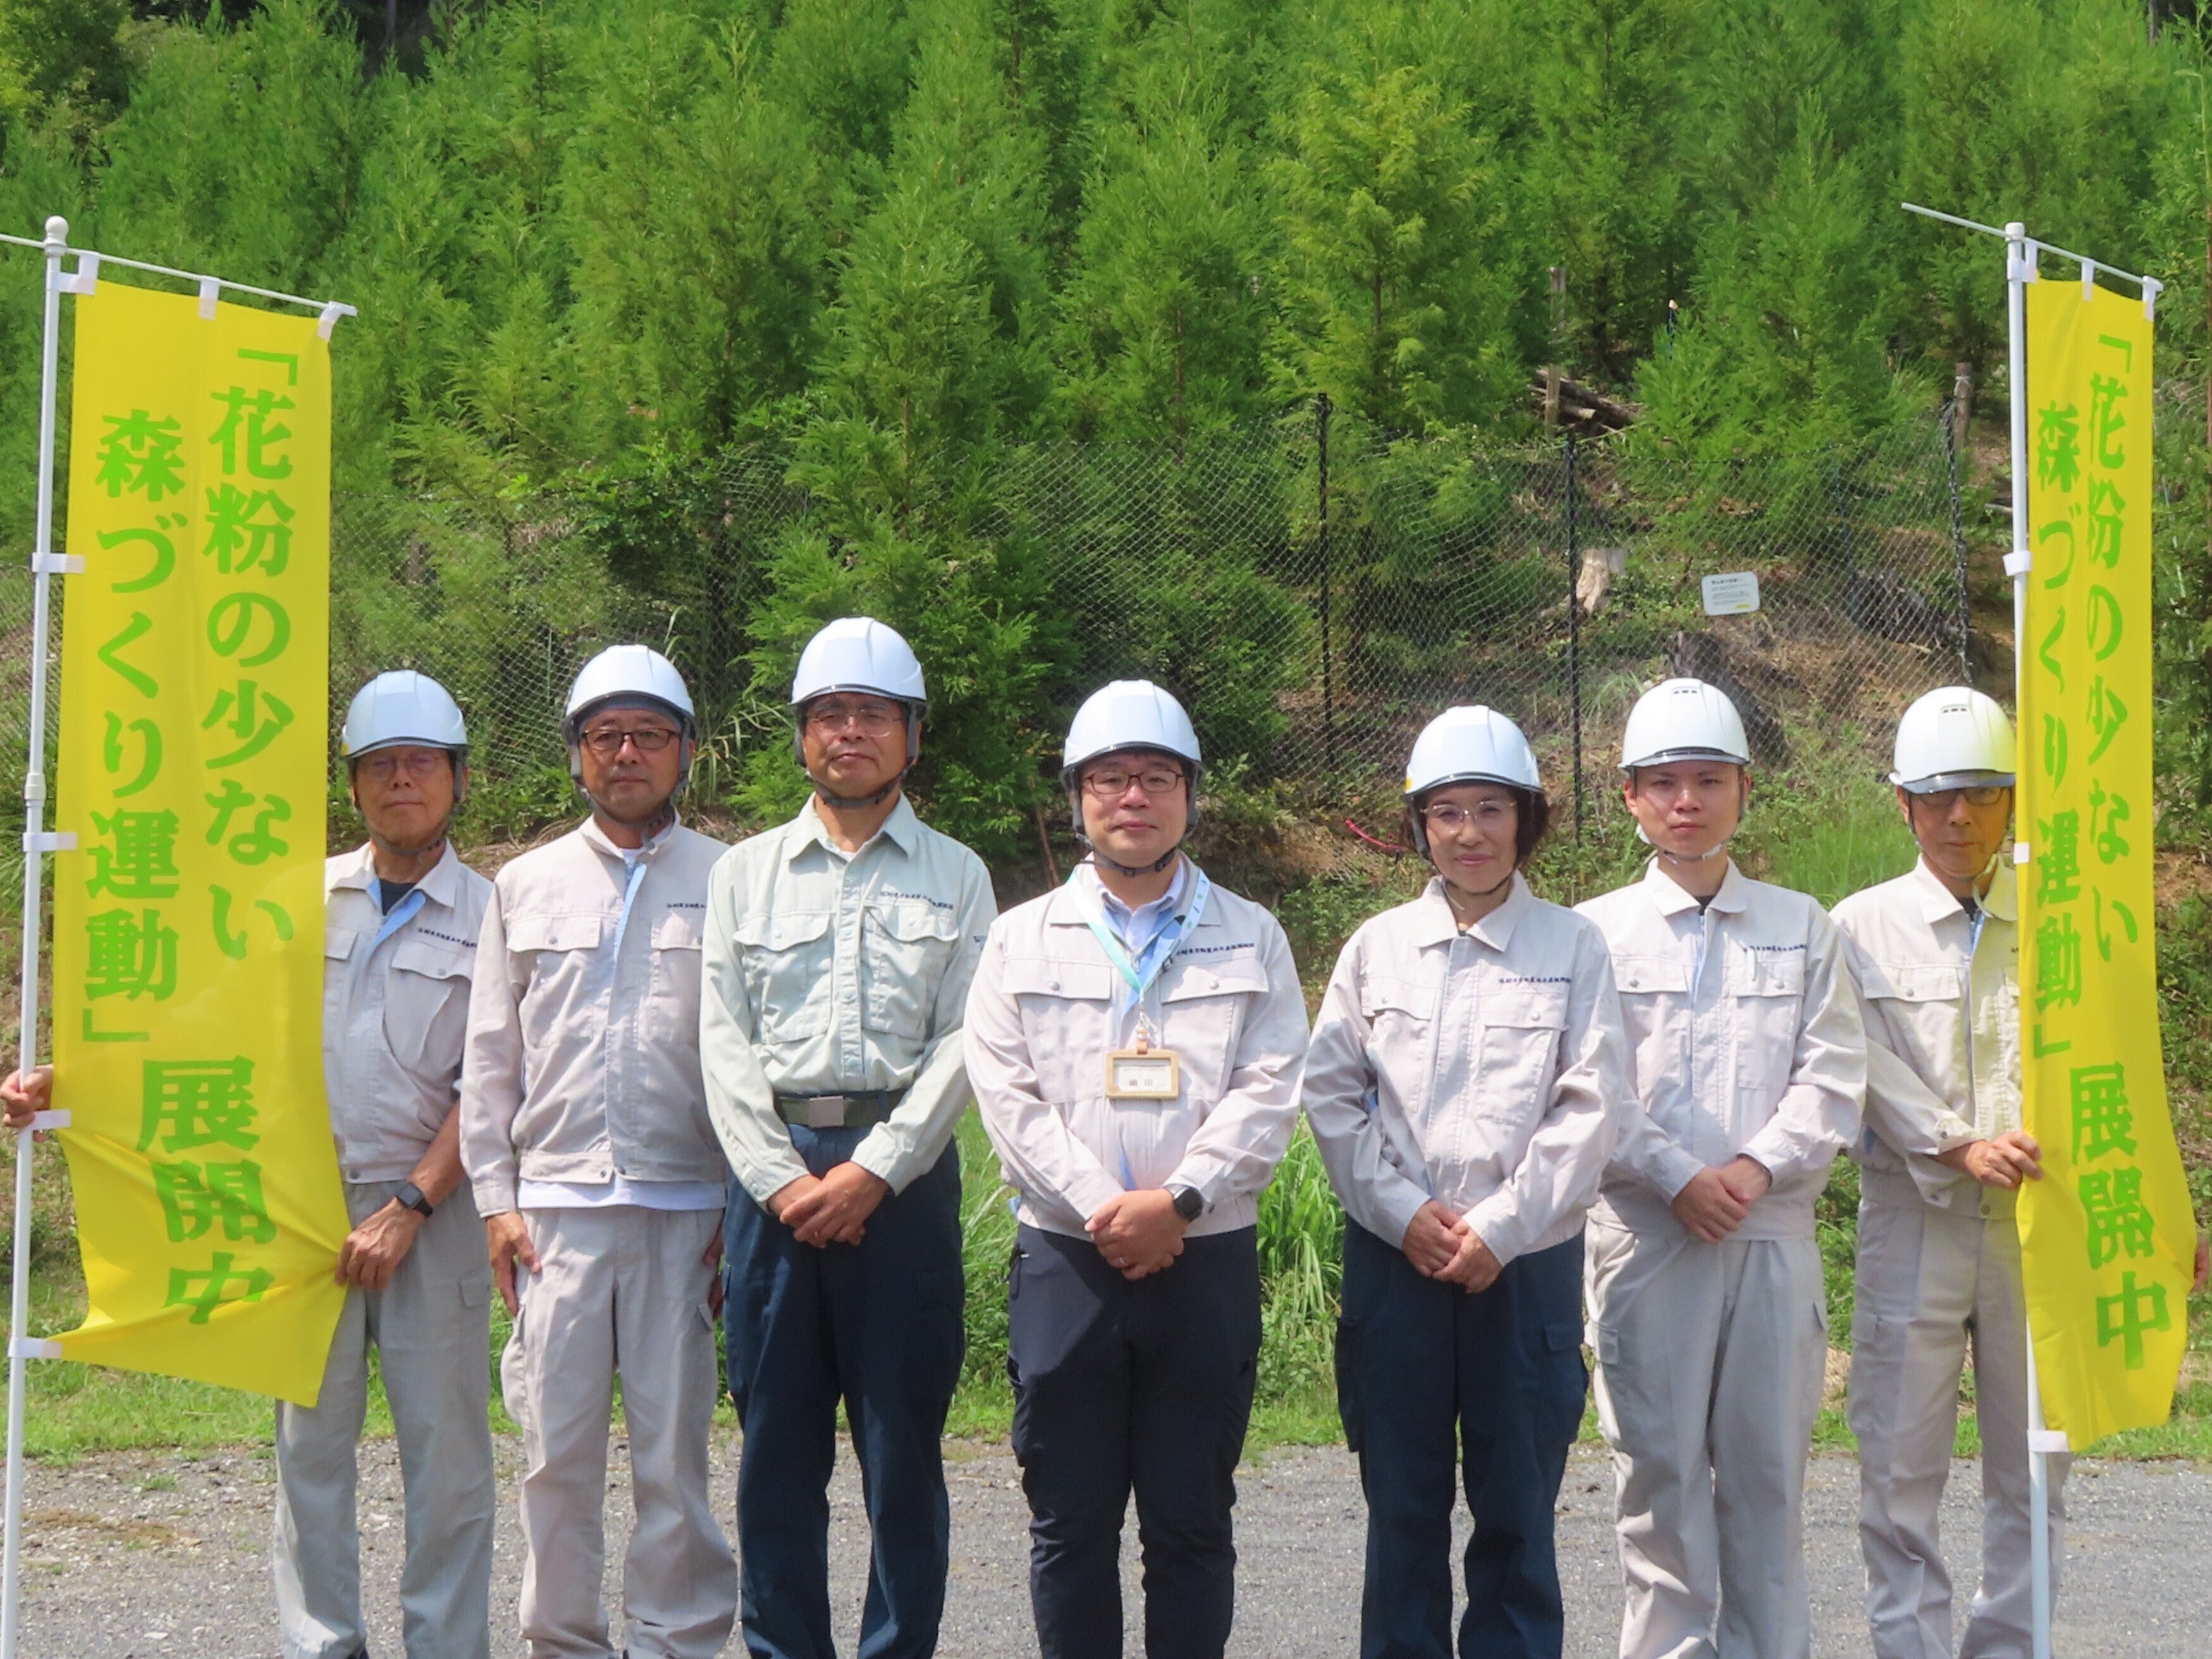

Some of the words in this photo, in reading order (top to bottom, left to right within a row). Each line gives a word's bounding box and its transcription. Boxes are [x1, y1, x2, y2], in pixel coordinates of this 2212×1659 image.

[83, 409, 188, 1042] 森づくり運動」
[202, 348, 298, 960] 「花粉の少ない
[2033, 401, 2082, 1058] 森づくり運動」
[2086, 335, 2138, 962] 「花粉の少ない
[138, 1055, 277, 1325] 展開中
[2070, 1062, 2170, 1369] 展開中
